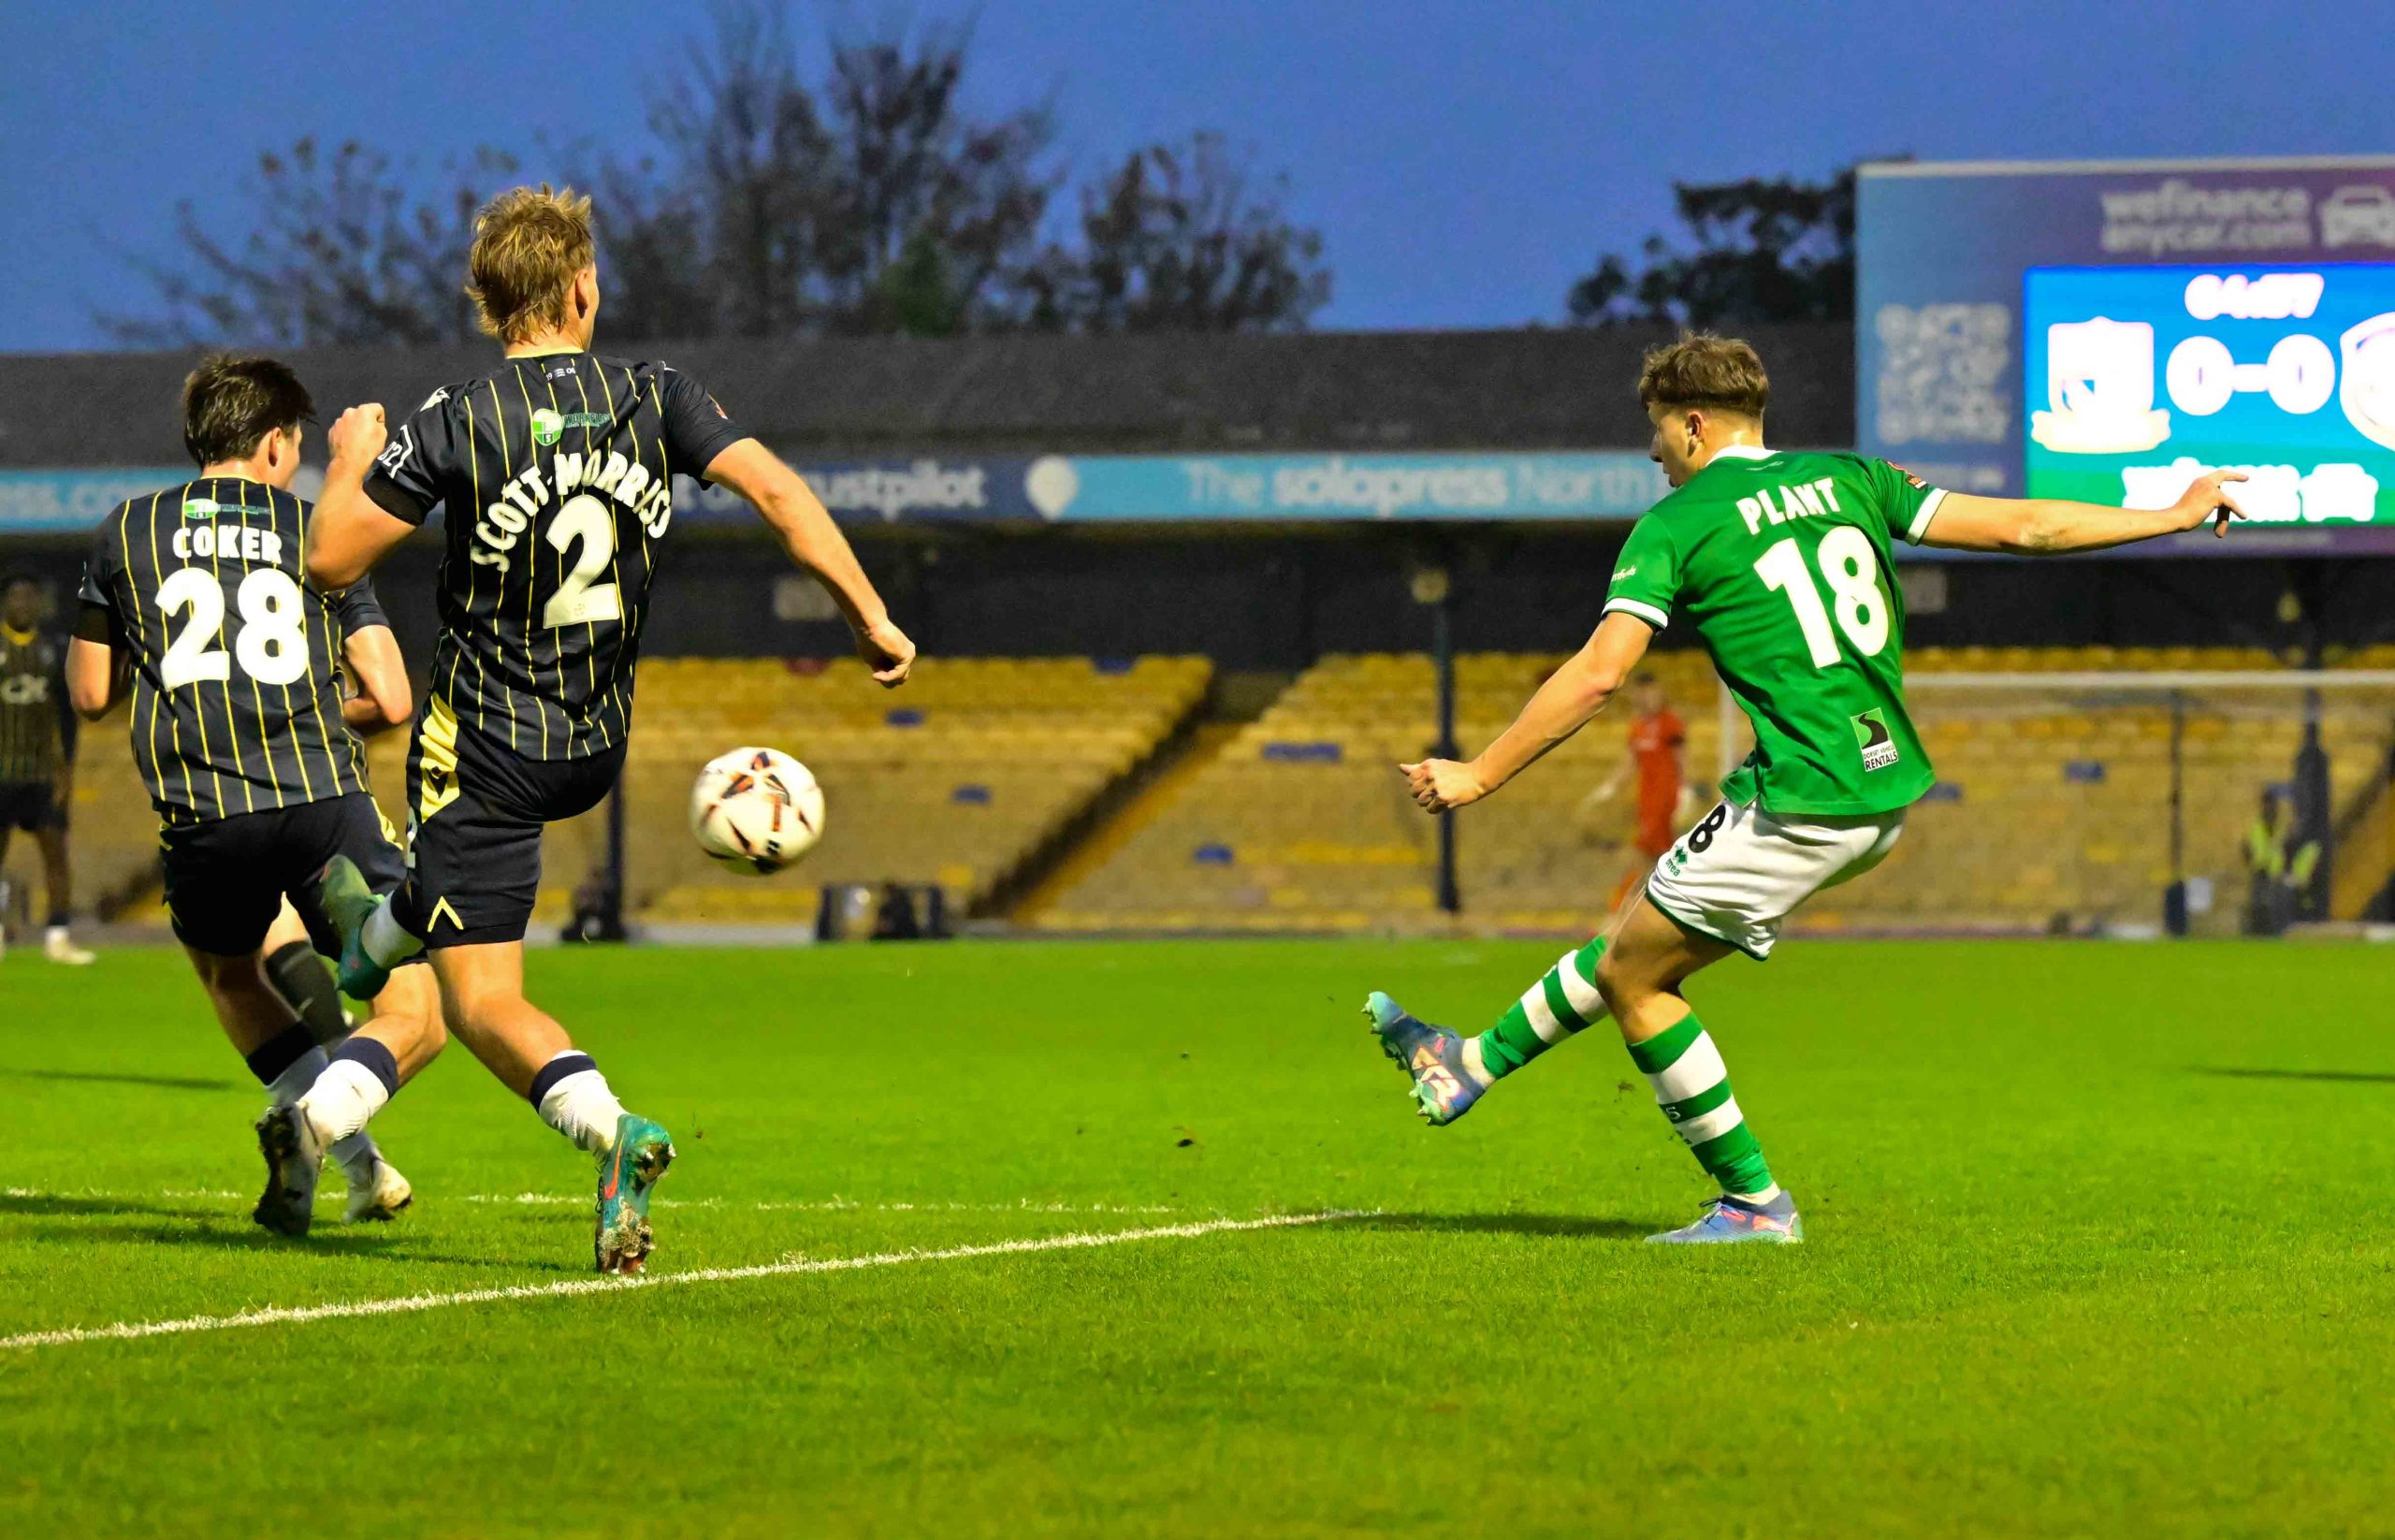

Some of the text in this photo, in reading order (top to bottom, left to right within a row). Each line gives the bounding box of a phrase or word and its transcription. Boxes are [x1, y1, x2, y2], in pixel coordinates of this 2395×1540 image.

[1186, 458, 1262, 505] The
[1273, 456, 1510, 520] solopress
[1517, 460, 1650, 506] North
[1736, 477, 1840, 535] PLANT
[172, 525, 283, 564] COKER
[543, 494, 620, 629] 2
[154, 567, 310, 692] 28
[1753, 526, 1889, 669] 18
[1865, 751, 1898, 771] RENTALS
